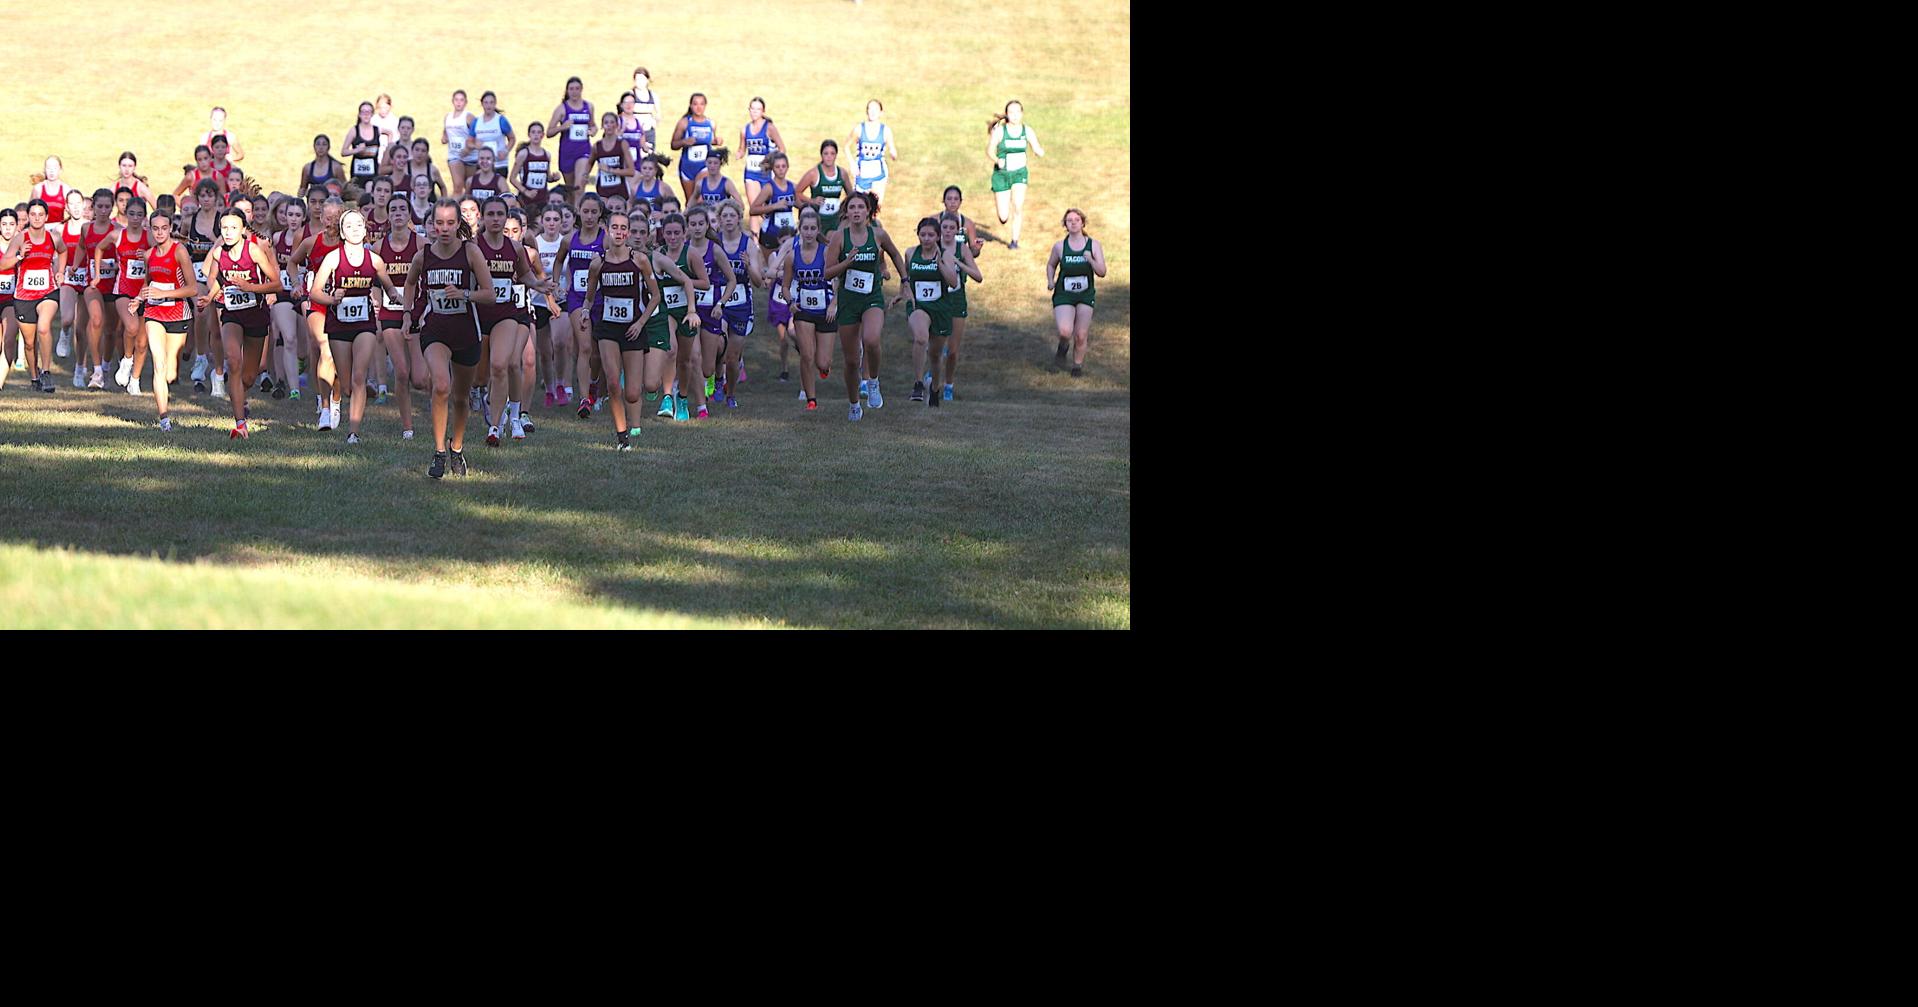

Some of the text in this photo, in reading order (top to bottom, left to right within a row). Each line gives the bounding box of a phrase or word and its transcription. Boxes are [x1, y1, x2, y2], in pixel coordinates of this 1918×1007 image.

[604, 174, 617, 183] 137
[825, 203, 835, 211] 34
[845, 252, 876, 261] TCONIC
[487, 260, 514, 273] ENOX
[911, 262, 938, 271] TACONIC
[27, 276, 45, 286] 268
[69, 273, 85, 282] 269
[427, 269, 462, 285] MONUMENT
[601, 271, 634, 286] MONUMENT
[341, 277, 372, 288] LENOX
[852, 277, 865, 289] 35
[1071, 282, 1082, 290] 28
[923, 288, 934, 297] 37
[229, 292, 250, 305] 203
[666, 294, 679, 304] 32
[806, 296, 818, 306] 98
[343, 305, 364, 317] 197
[609, 305, 628, 318] 138
